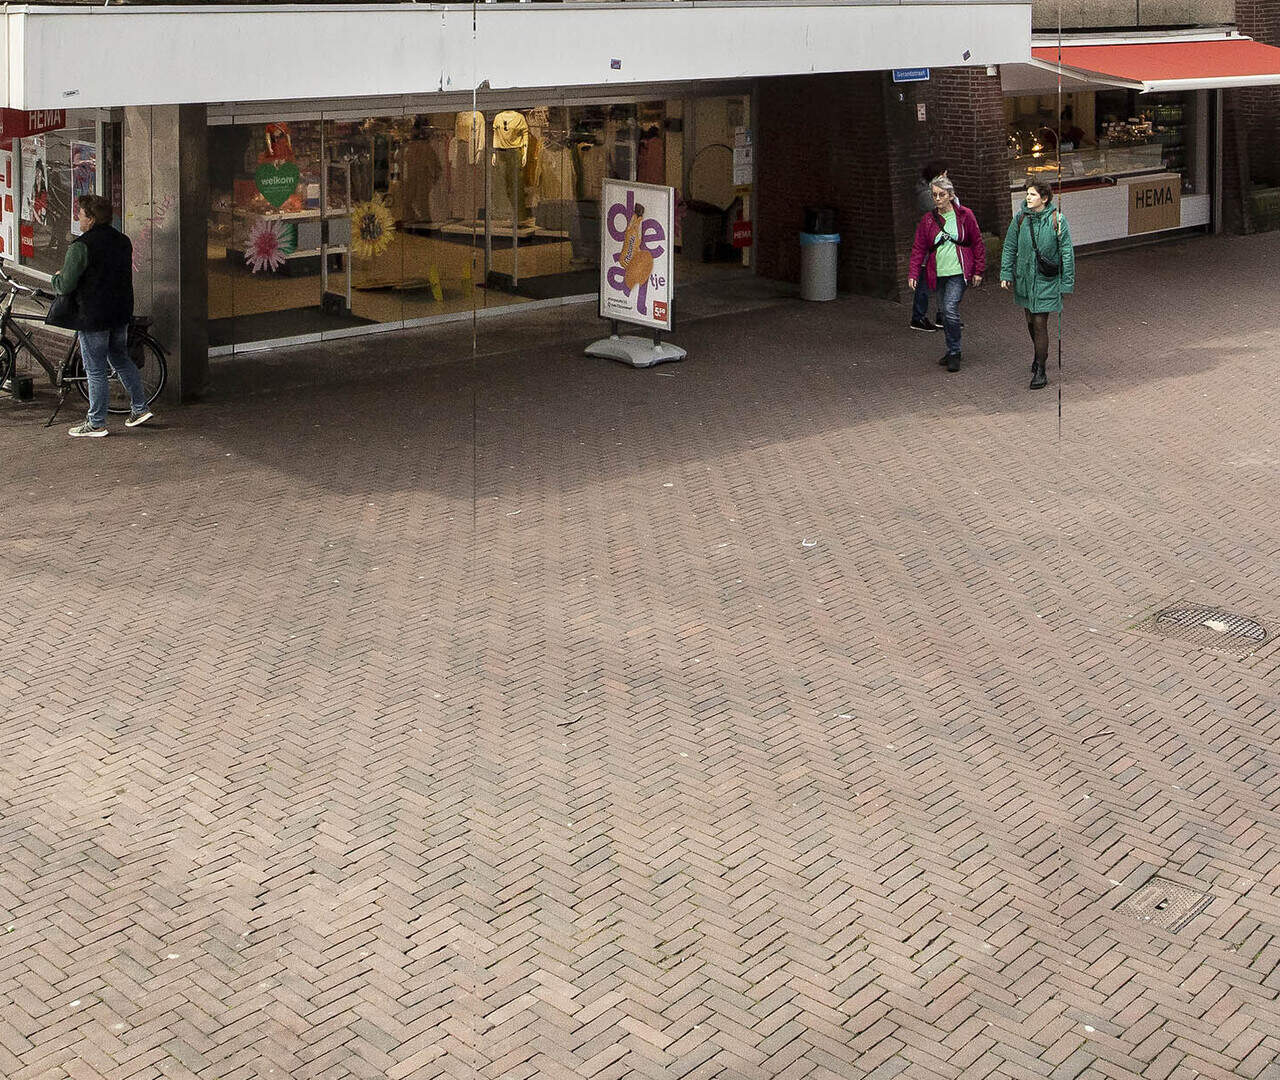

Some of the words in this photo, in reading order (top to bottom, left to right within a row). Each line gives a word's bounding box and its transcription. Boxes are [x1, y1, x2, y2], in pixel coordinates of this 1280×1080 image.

[28, 109, 61, 130] HEMA
[261, 176, 294, 185] welkom
[1135, 186, 1173, 209] HEMA
[733, 230, 752, 240] HEMA
